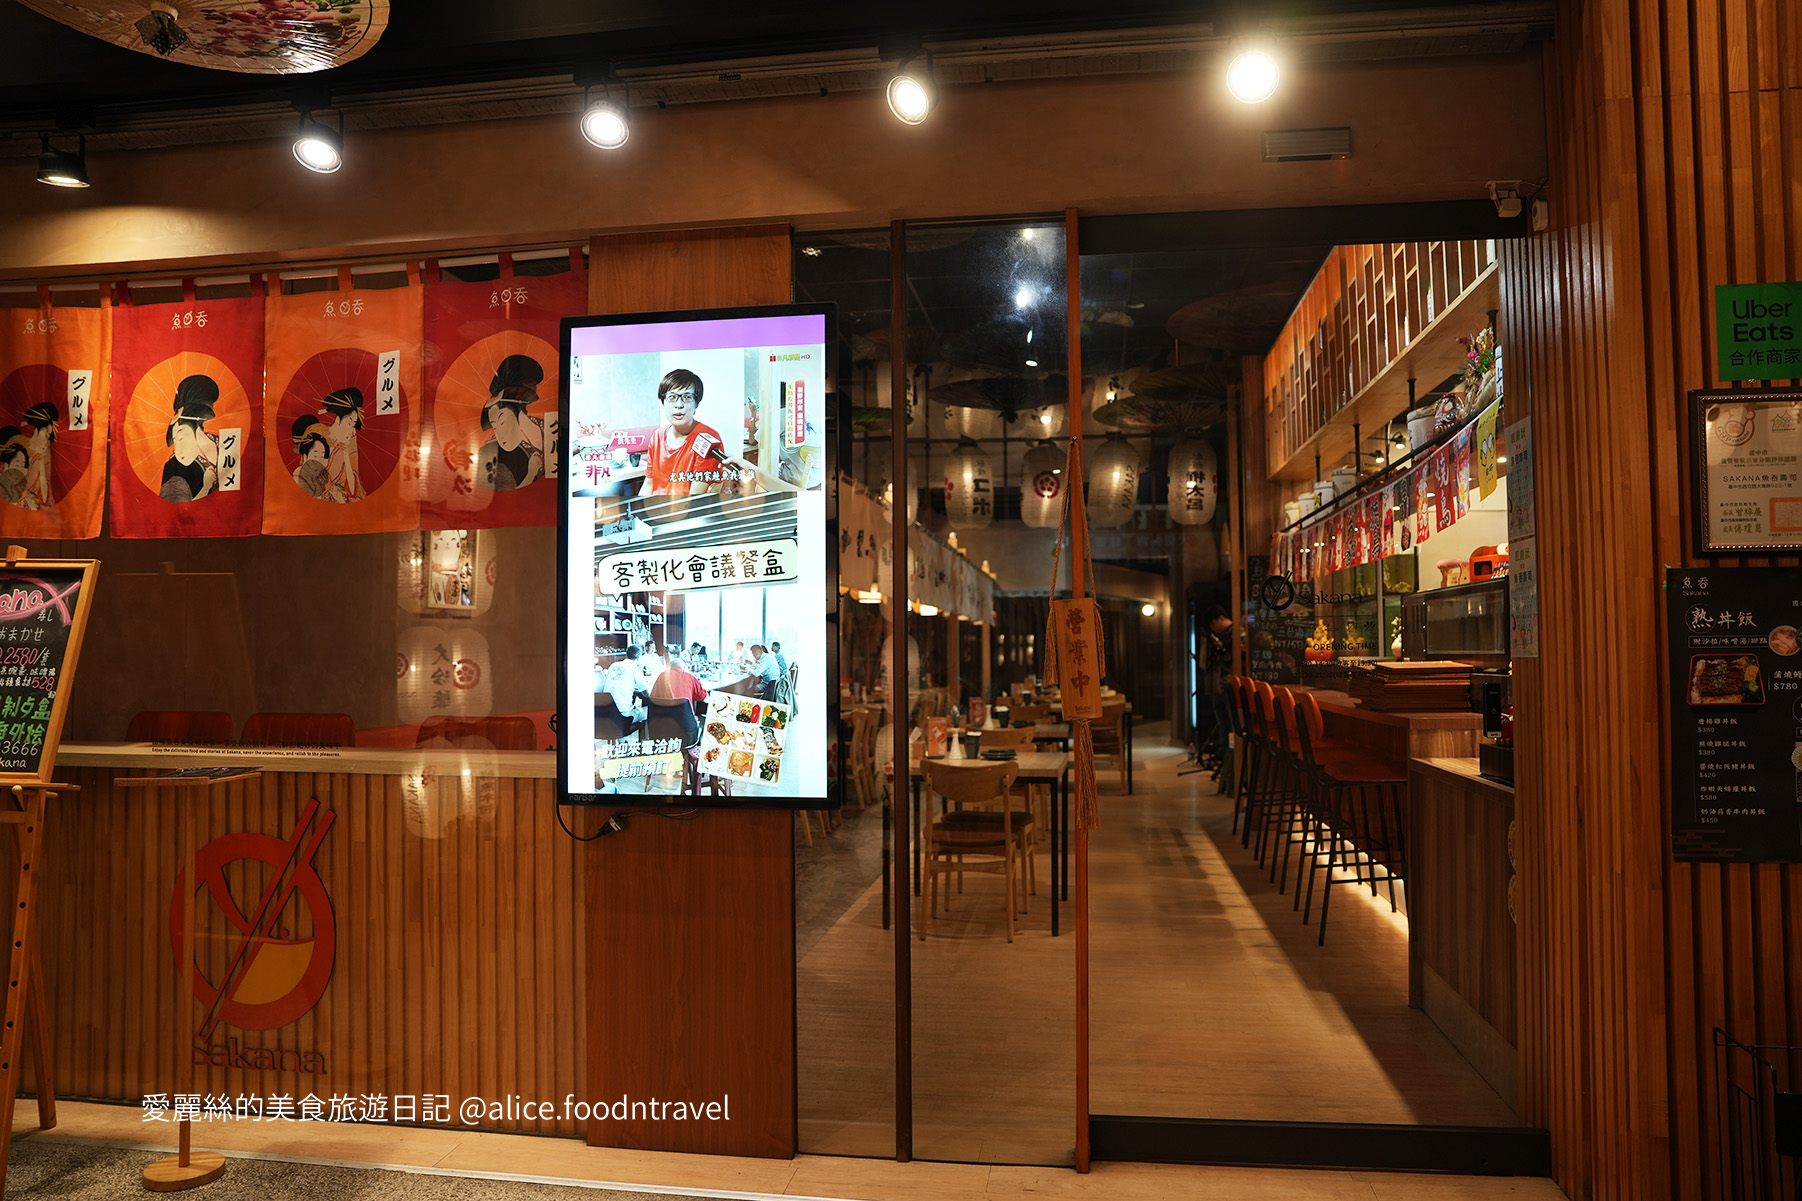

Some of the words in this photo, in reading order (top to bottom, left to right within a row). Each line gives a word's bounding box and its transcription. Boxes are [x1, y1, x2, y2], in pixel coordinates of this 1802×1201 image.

[1732, 299, 1793, 319] Uber
[1733, 323, 1795, 342] Eats
[1729, 348, 1802, 366] 合作商家
[381, 357, 396, 411] グルメ
[72, 376, 87, 427] グルメ
[222, 435, 237, 487] グルメ
[612, 549, 786, 588] 客製化會議餐盒
[1681, 576, 1710, 589] 魚吞
[1298, 590, 1363, 605] Sakana
[1691, 606, 1758, 630] 熟丼飯
[1313, 643, 1354, 651] OPENING
[1356, 642, 1378, 650] TIME
[1773, 682, 1798, 691] $780
[601, 737, 682, 760] 歡迎來電洽詢
[616, 760, 671, 779] 提前預訂
